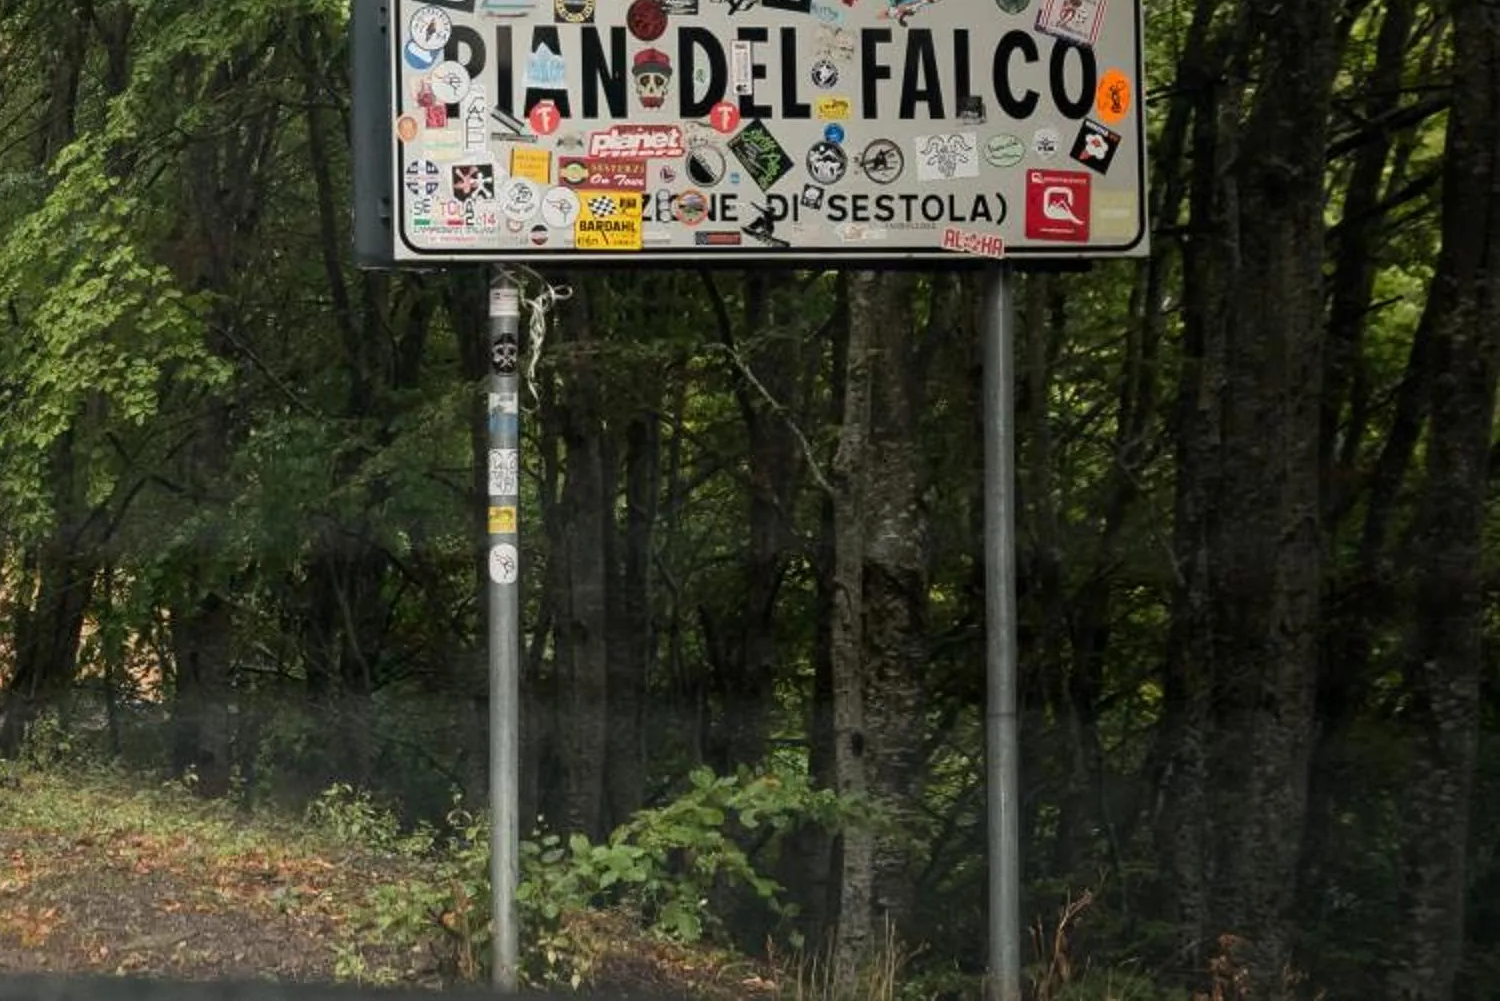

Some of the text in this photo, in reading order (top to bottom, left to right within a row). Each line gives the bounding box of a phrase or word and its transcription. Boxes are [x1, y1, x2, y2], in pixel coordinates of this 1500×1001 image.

[678, 27, 812, 119] DEL
[861, 27, 1097, 120] FALCO
[766, 194, 799, 222] DI
[827, 192, 1007, 225] SESTOLA)
[580, 220, 637, 232] BARDAHL
